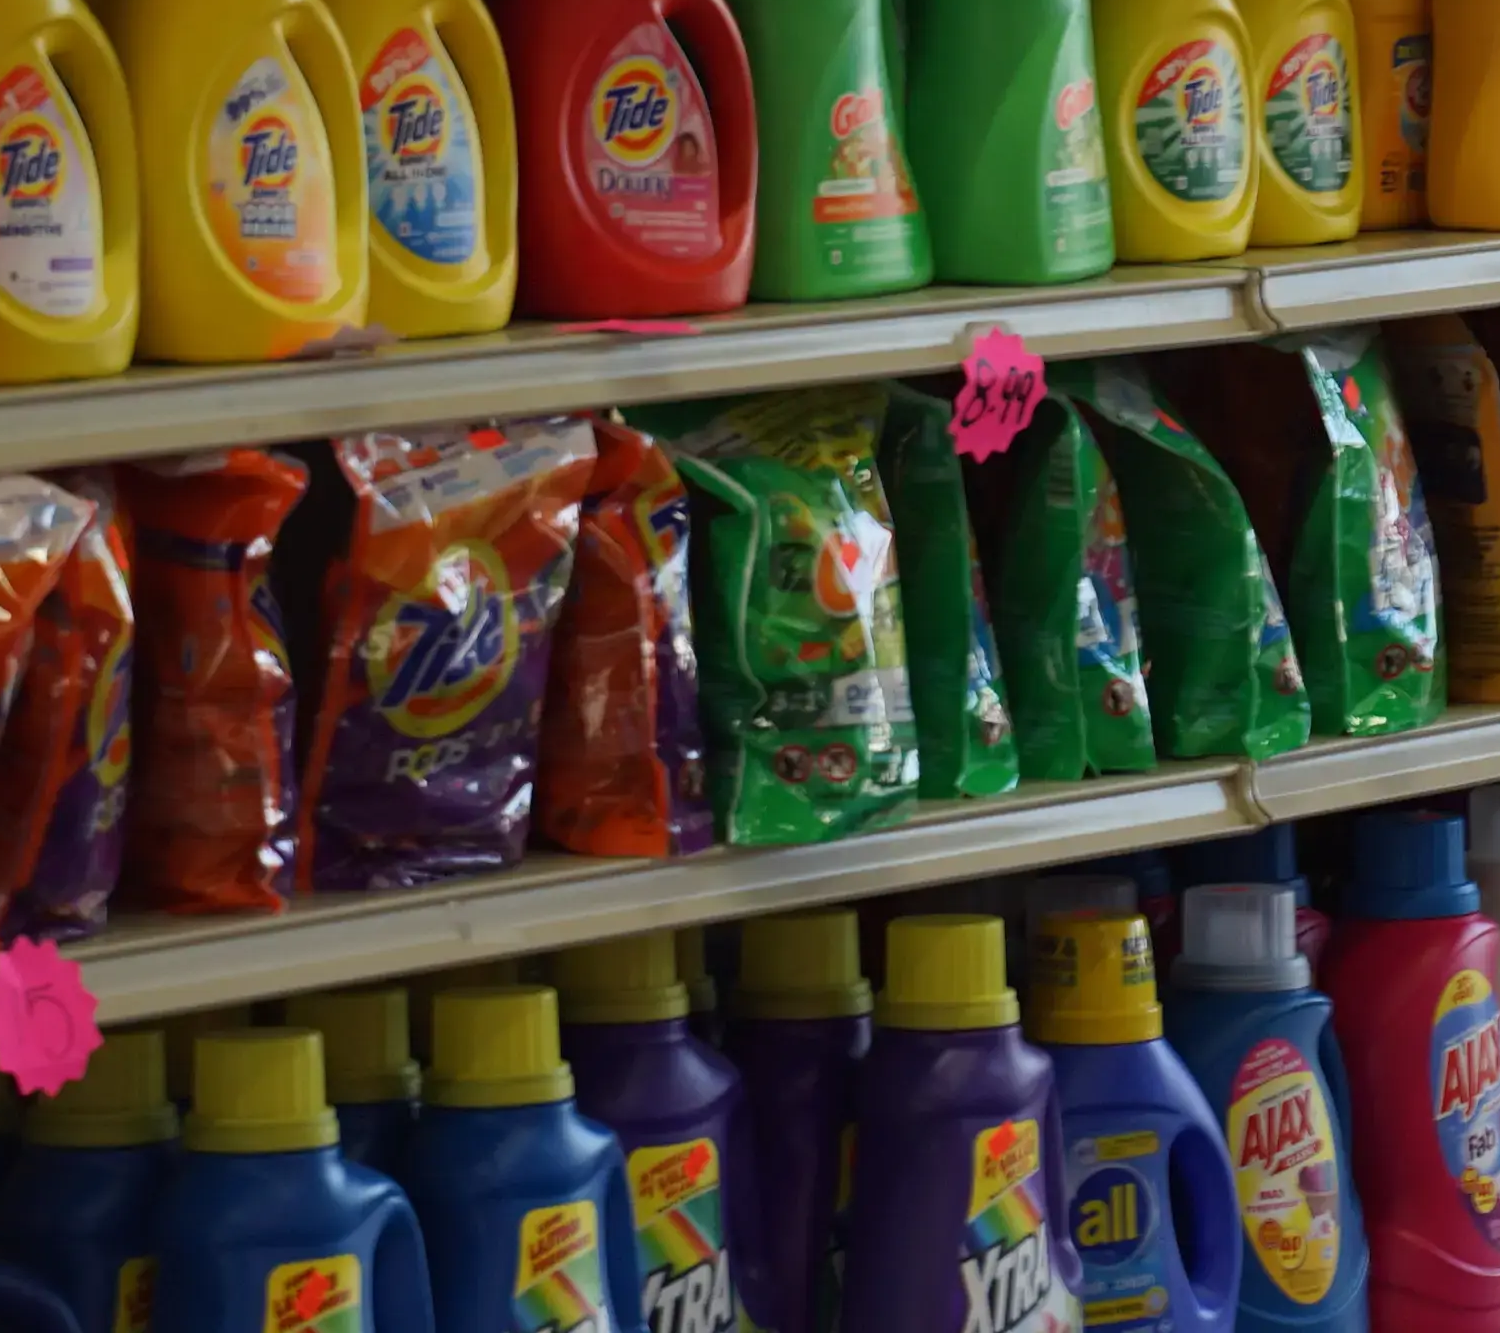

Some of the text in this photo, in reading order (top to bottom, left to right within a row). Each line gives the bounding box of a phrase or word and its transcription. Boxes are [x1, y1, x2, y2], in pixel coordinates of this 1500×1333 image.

[604, 85, 670, 143] Tide
[830, 89, 886, 139] Ga
[1055, 77, 1095, 130] Ga
[1184, 79, 1225, 124] Tide
[1306, 72, 1340, 118] Tide
[387, 99, 445, 156] Tide
[1, 137, 61, 198] Tide
[242, 132, 298, 186] Tide
[597, 167, 673, 201] Downy
[963, 361, 1035, 425] 8.99
[384, 583, 512, 713] Tide
[386, 741, 469, 783] PODS
[1239, 1087, 1315, 1170] AJAX
[1467, 1127, 1497, 1161] Fab
[1078, 1182, 1139, 1247] all
[960, 1223, 1053, 1333] XTRA
